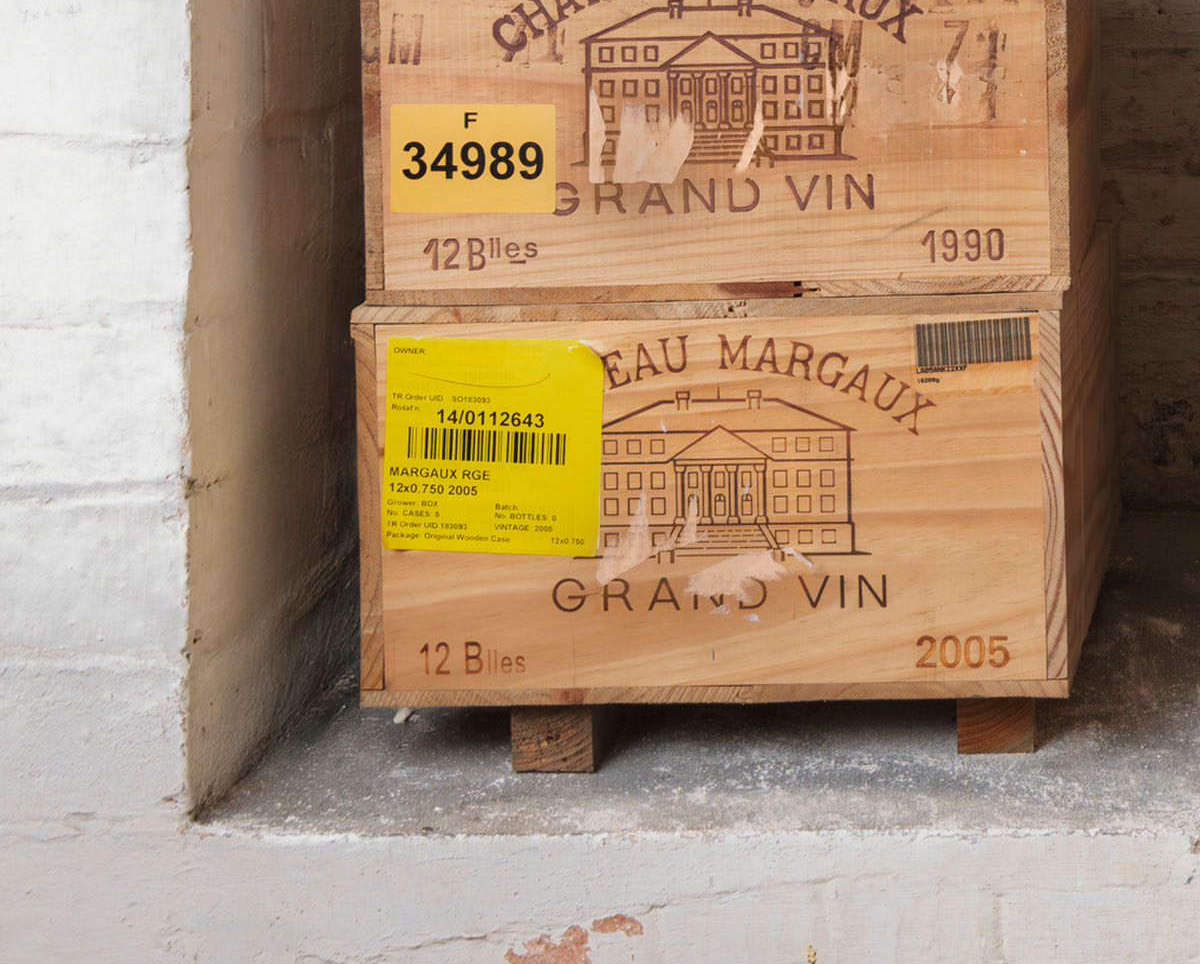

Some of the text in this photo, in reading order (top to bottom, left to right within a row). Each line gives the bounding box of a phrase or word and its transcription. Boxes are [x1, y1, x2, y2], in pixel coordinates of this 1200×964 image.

[464, 112, 478, 129] F
[402, 141, 544, 180] 34989
[553, 174, 875, 216] GRAND VIN
[921, 227, 1005, 263] 1990
[601, 334, 936, 436] EAU MARGAUX
[405, 393, 426, 401] Order
[436, 408, 545, 429] 14/0112643
[389, 466, 490, 481] MARGAUX RGE
[389, 482, 478, 496] 12x0.750 2005
[421, 499, 438, 507] BDX
[400, 520, 421, 529] Order
[424, 521, 438, 529] UID
[534, 524, 553, 533] 2005
[424, 532, 455, 541] Original
[457, 533, 489, 542] Wooden
[798, 574, 887, 609] VIN
[419, 642, 450, 675] 12
[915, 635, 1010, 669] 2005
